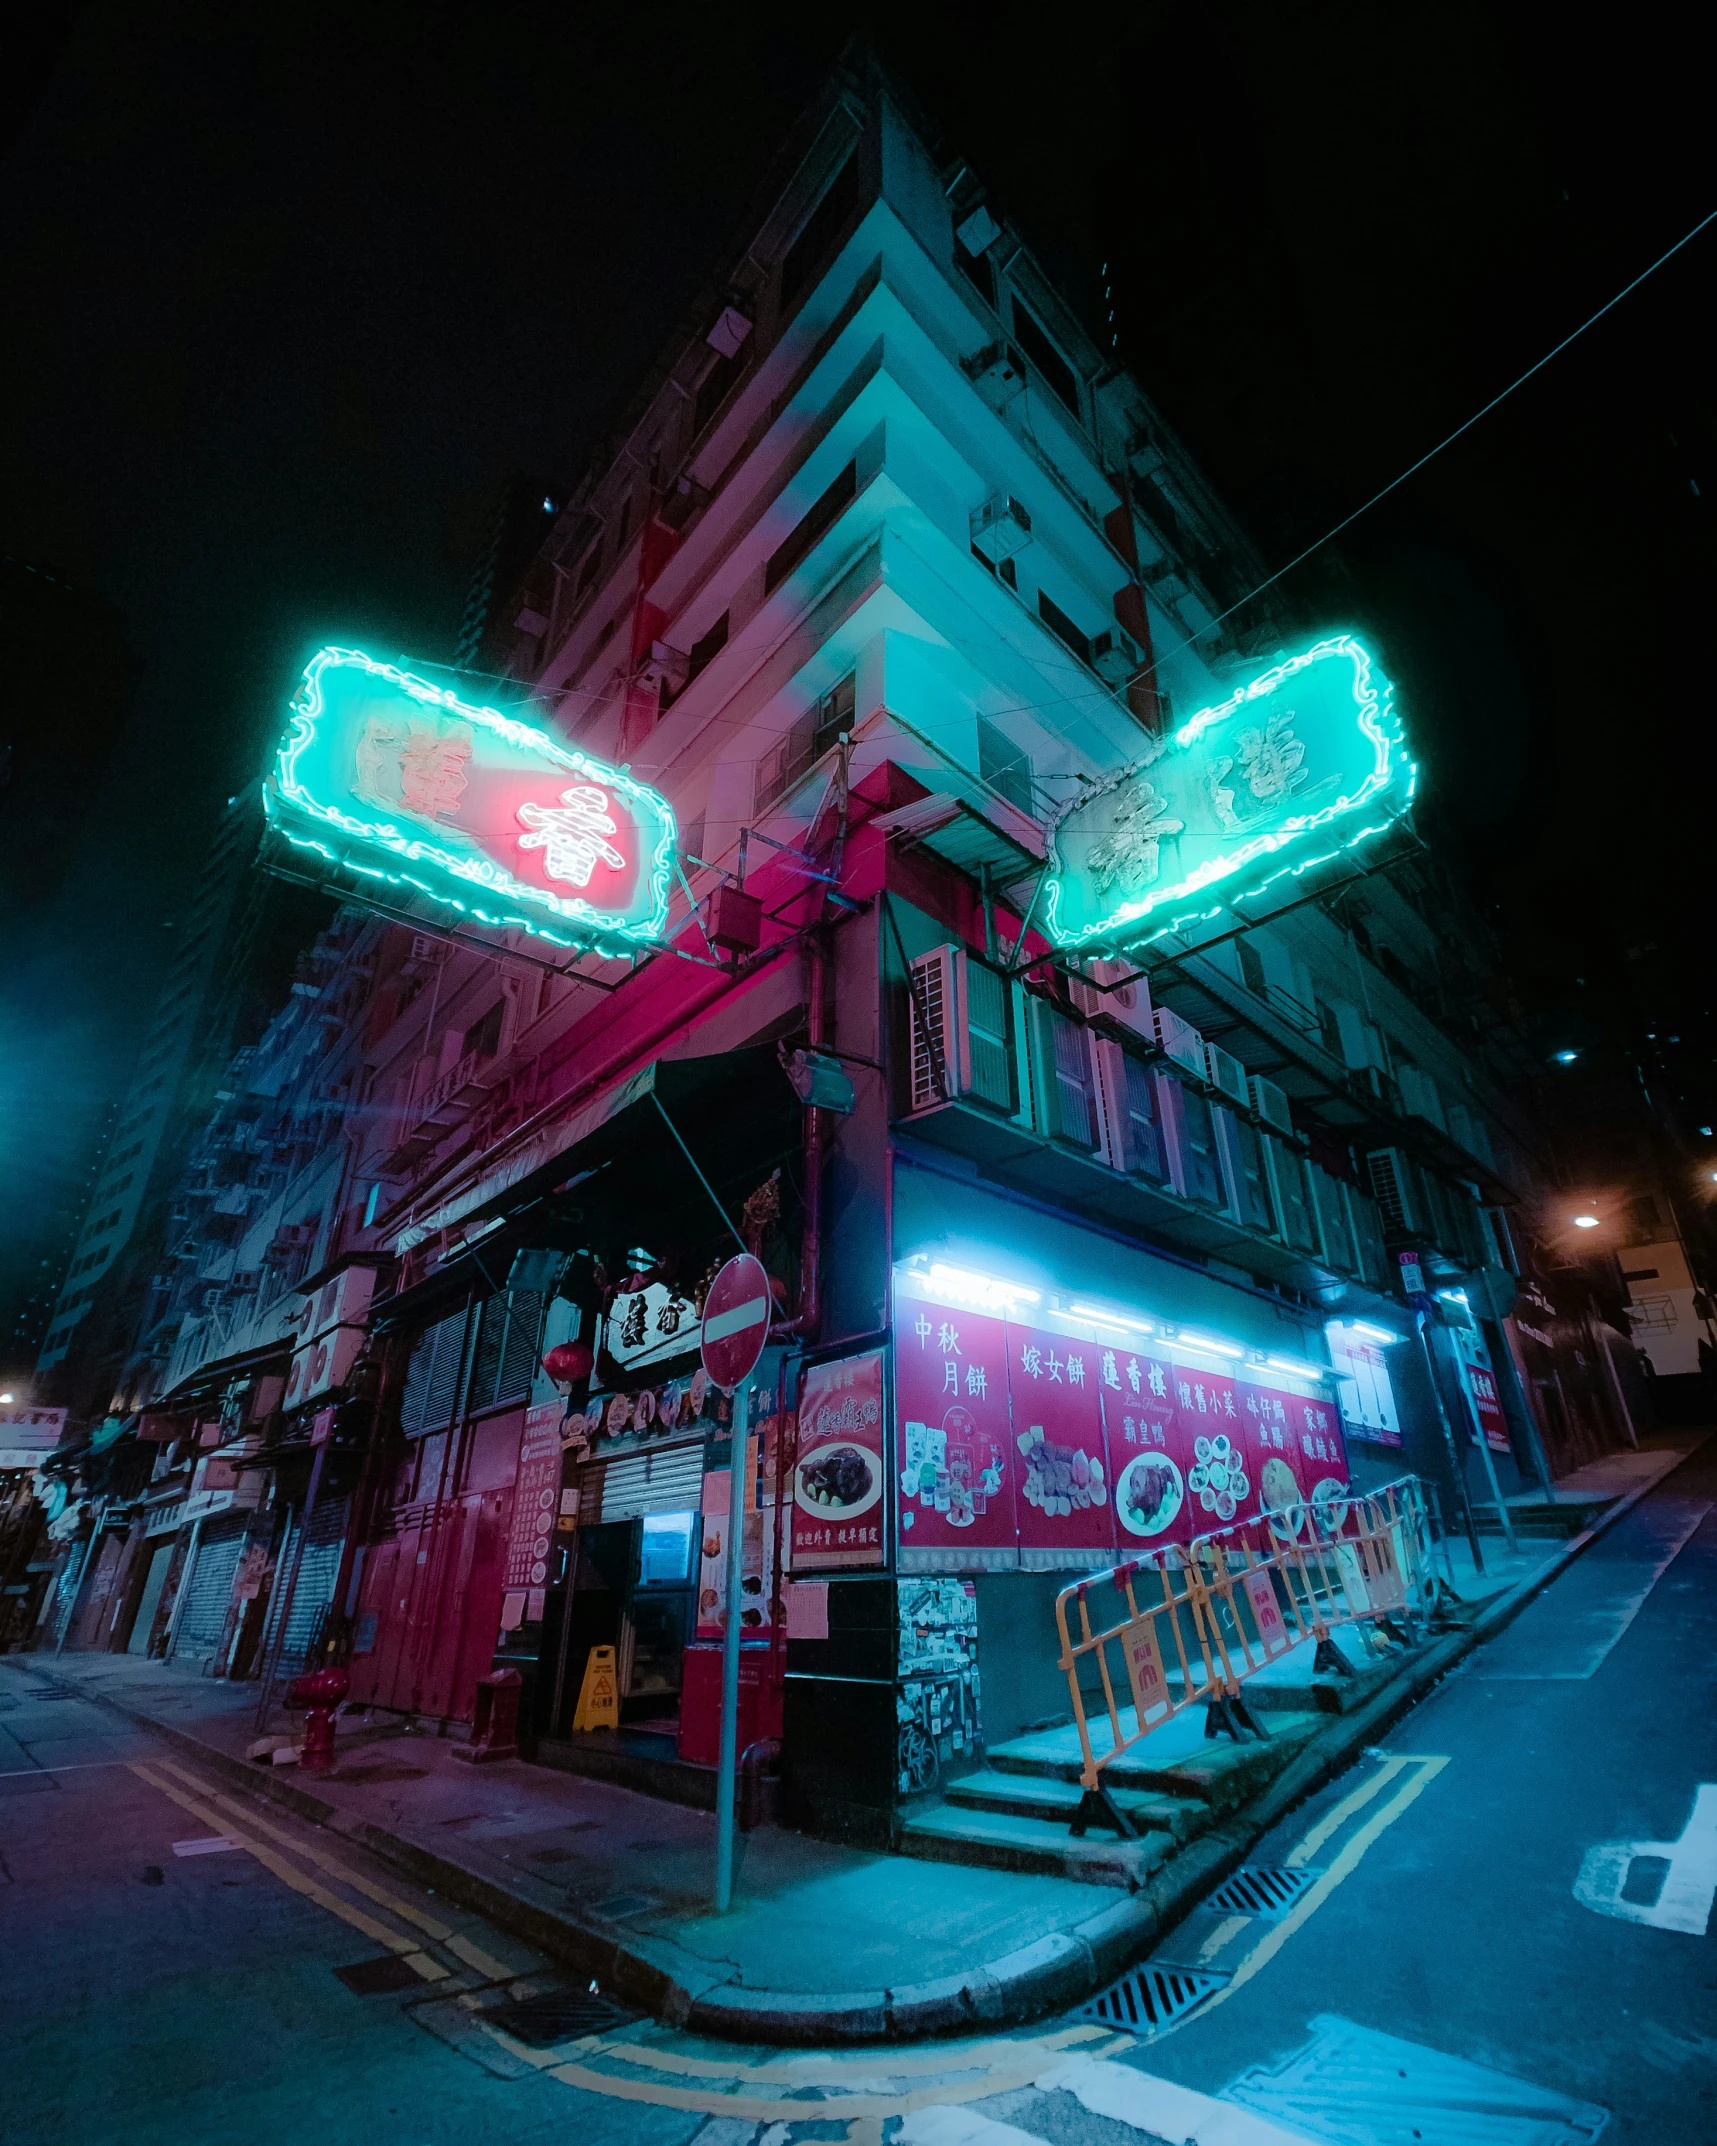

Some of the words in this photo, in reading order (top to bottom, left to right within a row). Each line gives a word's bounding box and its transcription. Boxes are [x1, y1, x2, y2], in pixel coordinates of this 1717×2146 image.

[914, 1313, 963, 1356] 中秋
[941, 1360, 989, 1402] 月餅
[1020, 1344, 1086, 1390] 嫁女餅
[1102, 1350, 1168, 1401] 蓮香樓
[1179, 1382, 1238, 1419] 懷舊小菜
[1123, 1416, 1166, 1447] 霸皇鴨
